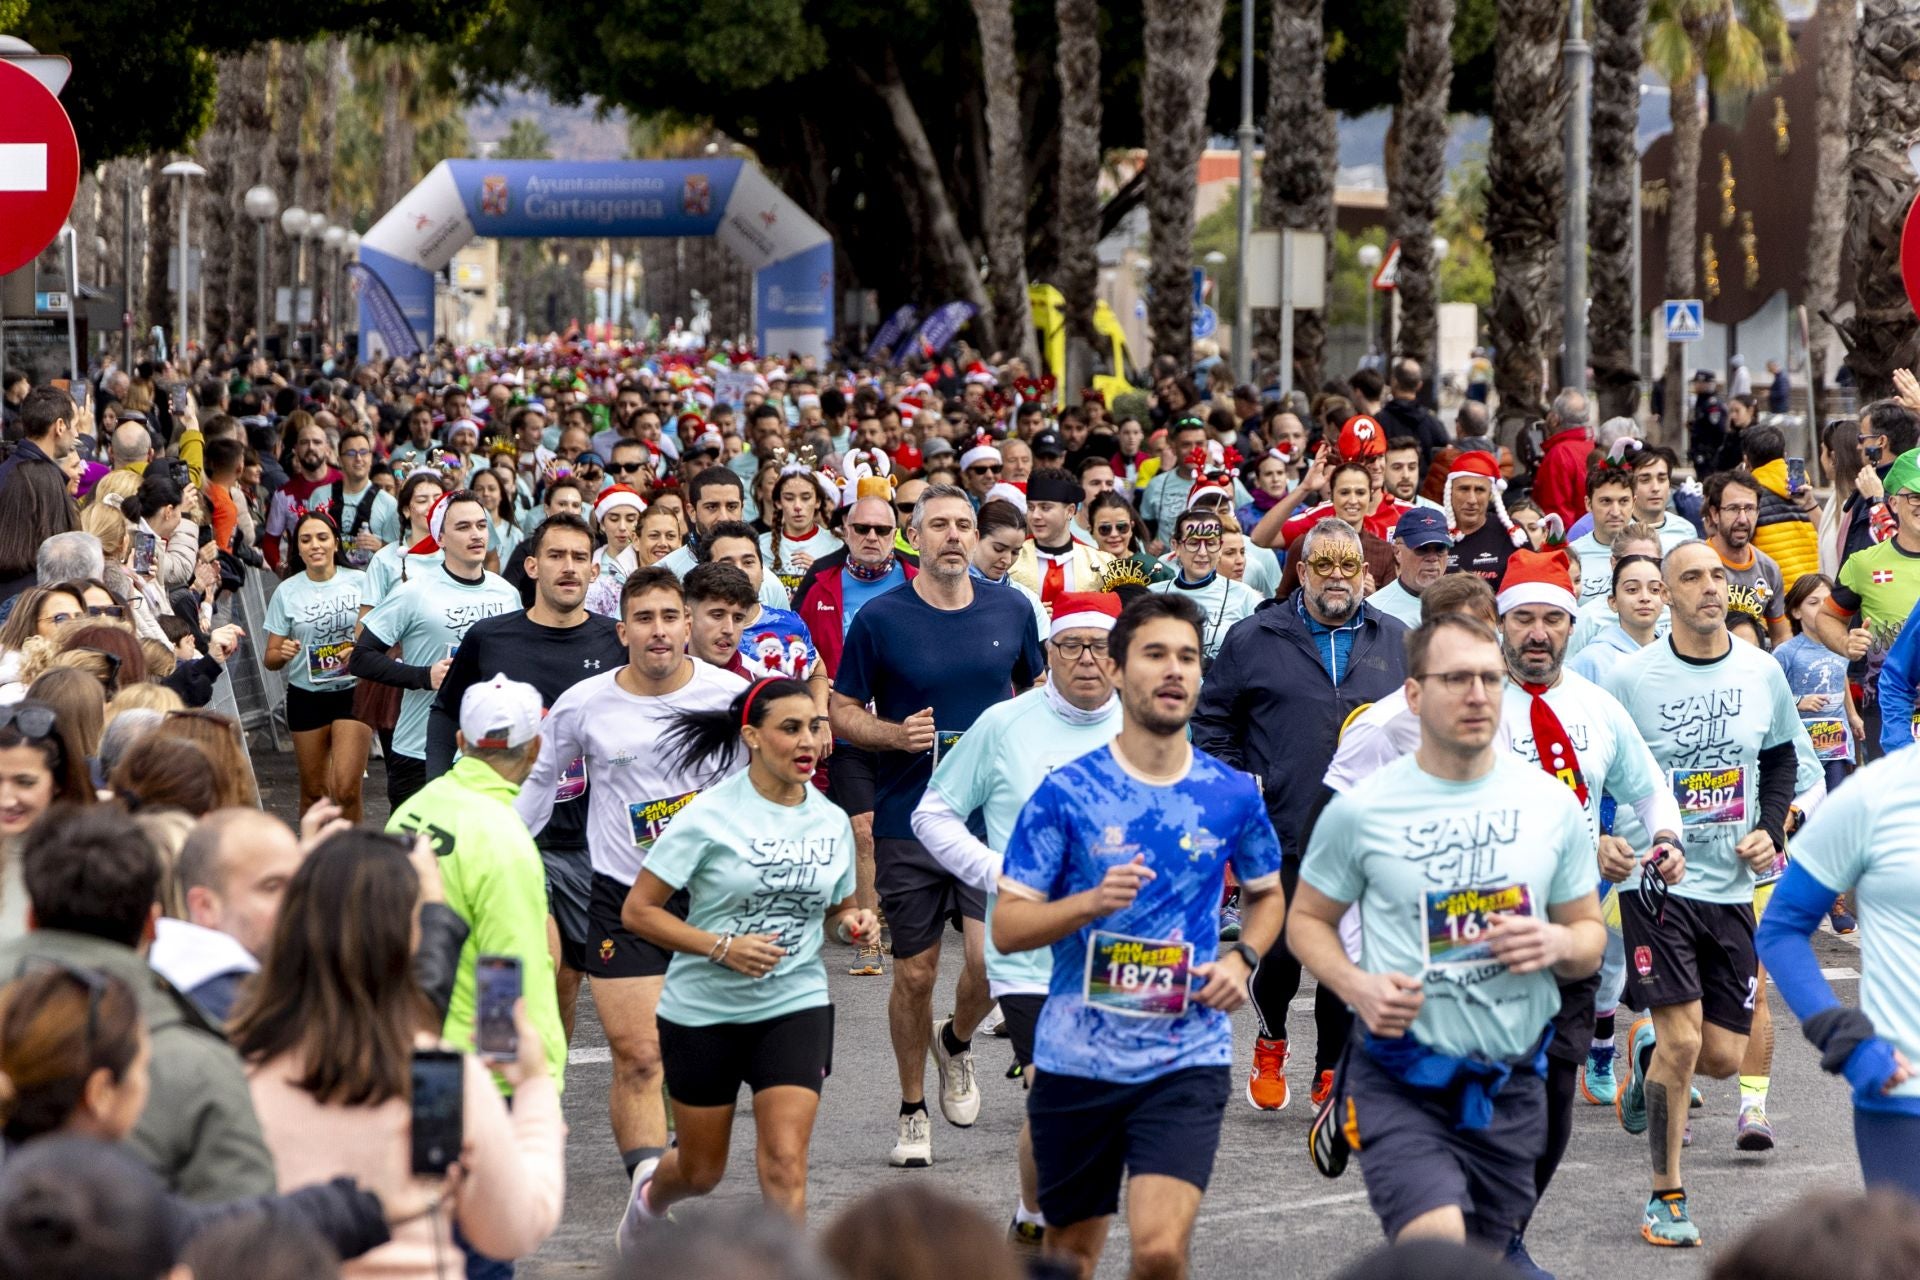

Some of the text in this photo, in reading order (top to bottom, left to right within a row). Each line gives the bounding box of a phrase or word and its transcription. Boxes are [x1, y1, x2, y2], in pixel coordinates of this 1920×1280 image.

[526, 175, 664, 193] Ayuntamiento
[525, 193, 663, 223] Cartagena
[1186, 522, 1223, 537] 2025
[1107, 559, 1144, 573] FELIZ
[1728, 584, 1757, 597] ELIZ
[304, 594, 360, 623] SAN
[445, 602, 503, 628] SAN
[1660, 688, 1742, 731] SAN
[1674, 719, 1734, 758] SIL
[1689, 772, 1712, 783] SAN
[1689, 769, 1740, 790] SILVESTRE
[645, 800, 667, 815] SAN
[1686, 787, 1735, 810] 2507
[1404, 809, 1519, 861] SAN
[747, 837, 835, 868] SAN
[753, 866, 821, 897] SIL
[1113, 942, 1143, 955] SAN
[1107, 961, 1174, 995] 1873
[1744, 976, 1758, 1010] 2
